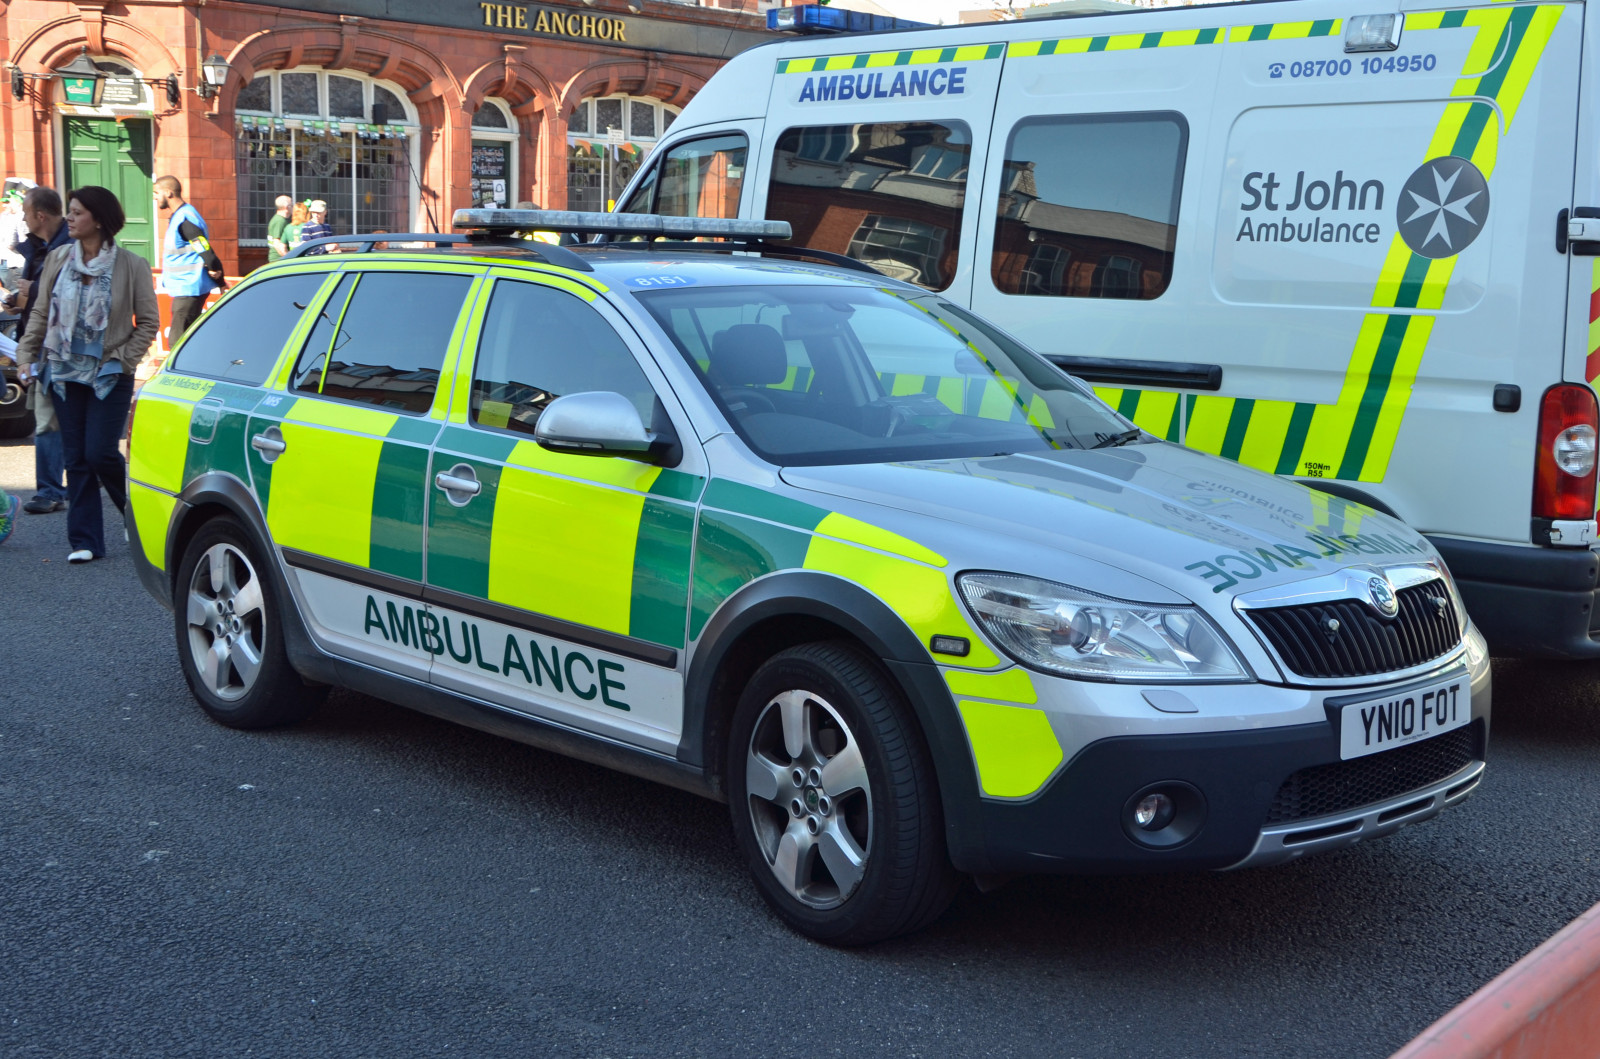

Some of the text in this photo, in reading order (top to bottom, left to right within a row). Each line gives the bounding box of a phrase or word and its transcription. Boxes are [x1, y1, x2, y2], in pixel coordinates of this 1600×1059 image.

[480, 2, 627, 42] THE ANCHOR
[1290, 54, 1437, 78] 08700 104950
[798, 67, 967, 103] AMBULANCE
[1240, 170, 1385, 212] St John
[1236, 216, 1380, 244] Ambulance
[634, 275, 687, 286] 8151
[262, 395, 283, 407] NHS
[1304, 462, 1331, 471] 150Nm
[1307, 469, 1323, 478] R55
[363, 594, 631, 712] AMBULANCE
[1360, 684, 1460, 746] YN10 FOT
